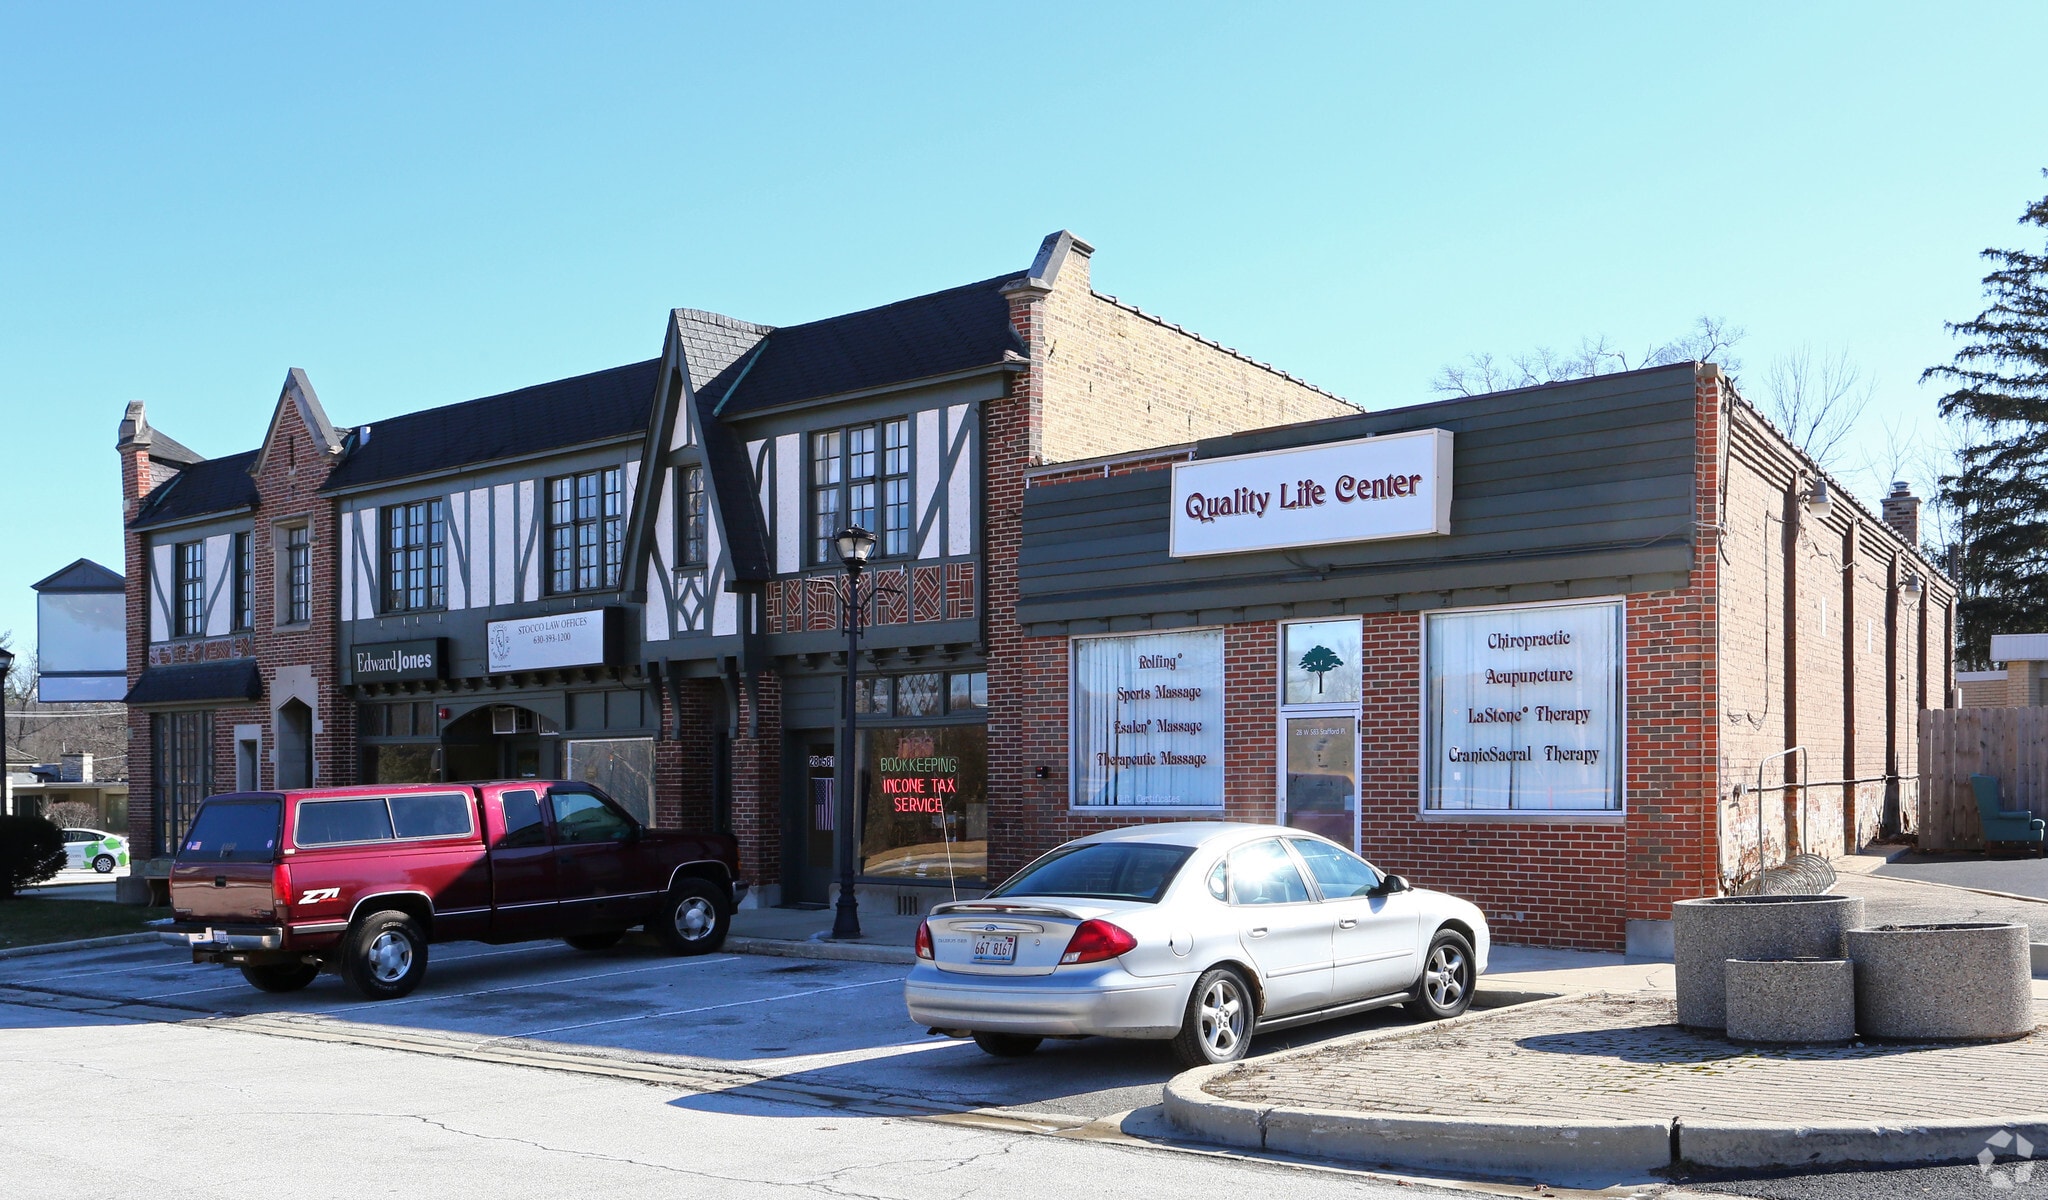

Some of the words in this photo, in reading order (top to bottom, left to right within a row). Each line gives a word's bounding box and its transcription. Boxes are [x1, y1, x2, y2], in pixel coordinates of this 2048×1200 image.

[1185, 486, 1270, 523] Quality
[1280, 479, 1326, 510] Life
[1335, 473, 1421, 503] Center
[518, 623, 545, 635] STOCCO
[545, 620, 561, 631] LAW
[561, 617, 588, 629] OFFICES
[533, 632, 571, 645] 630-393-1200
[1488, 630, 1571, 651] Chiropractic
[1485, 668, 1573, 687] Acupuncture
[1117, 686, 1151, 704] Sports
[1155, 684, 1201, 701] Massage
[1535, 705, 1591, 724] Therapy
[1157, 719, 1202, 735] Massage
[1096, 752, 1156, 769] Therapeutic
[1160, 751, 1207, 768] Massage
[1449, 746, 1532, 764] CranioSacral
[1543, 745, 1600, 765] Therapy
[880, 757, 957, 773] BOOKKEEPING
[931, 778, 956, 793] TAX
[894, 797, 943, 813] SERVICE
[298, 887, 341, 905] Z71
[975, 942, 991, 955] 667
[993, 943, 1013, 956] 8167
